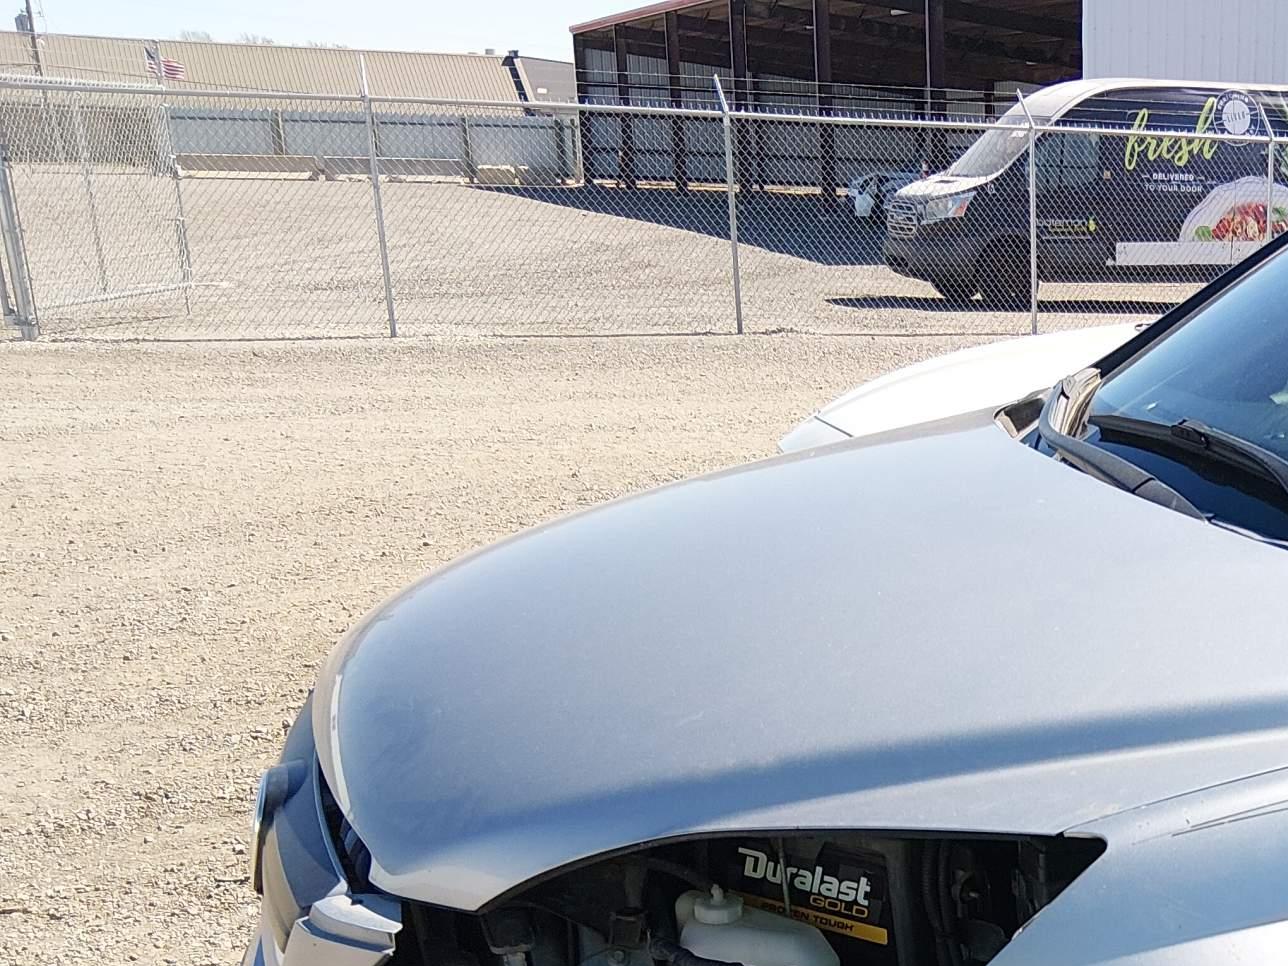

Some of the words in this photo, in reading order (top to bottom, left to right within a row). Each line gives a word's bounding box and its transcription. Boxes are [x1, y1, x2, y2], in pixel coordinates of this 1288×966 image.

[1125, 97, 1218, 170] fresh
[1152, 173, 1195, 181] DELIVERED
[1157, 184, 1179, 192] YOUR
[1180, 184, 1202, 193] DOOR
[738, 847, 871, 906] Duralast
[760, 902, 810, 921] PROEN
[813, 915, 855, 932] TOUGH
[809, 895, 869, 919] GOLD
